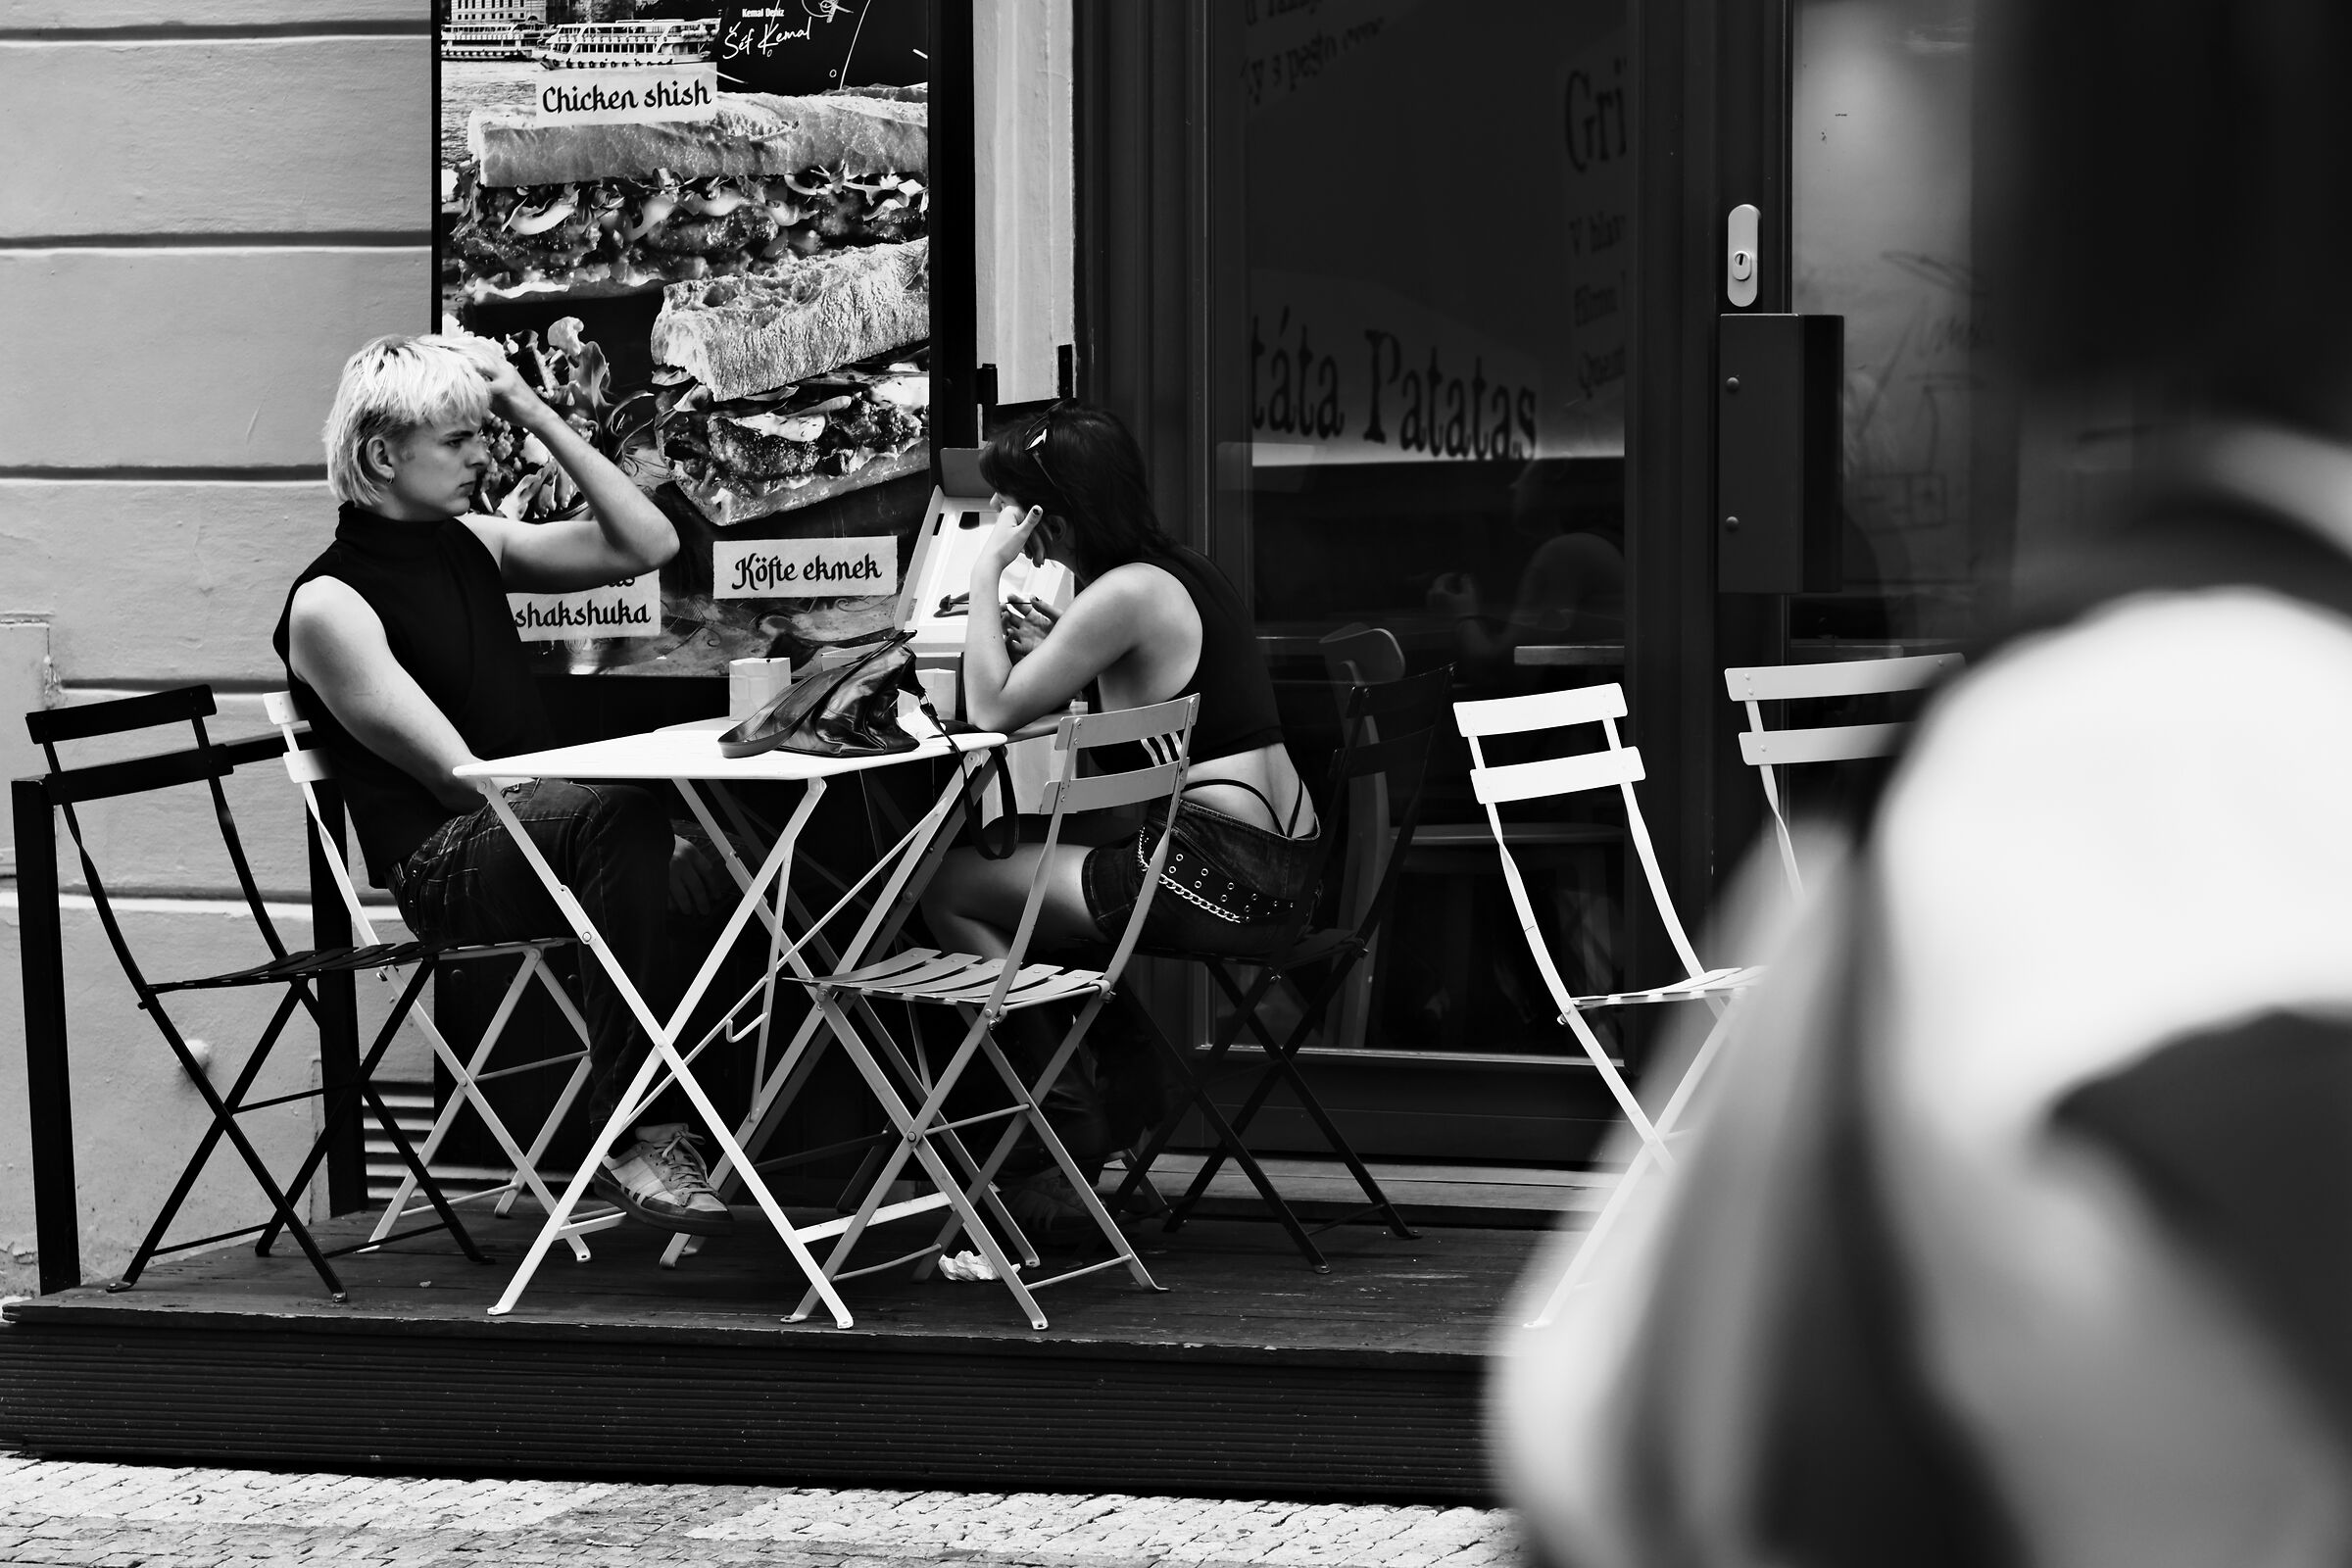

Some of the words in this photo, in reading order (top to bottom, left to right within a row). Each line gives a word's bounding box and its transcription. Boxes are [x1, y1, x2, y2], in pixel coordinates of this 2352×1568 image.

[742, 8, 763, 18] Kemal
[757, 16, 812, 55] Kemal
[542, 83, 640, 114] Chicken
[643, 78, 712, 109] shish
[1362, 328, 1537, 462] Patatas
[731, 552, 799, 591] Köfte
[803, 553, 883, 582] ekmek
[514, 598, 652, 629] shakshuka
